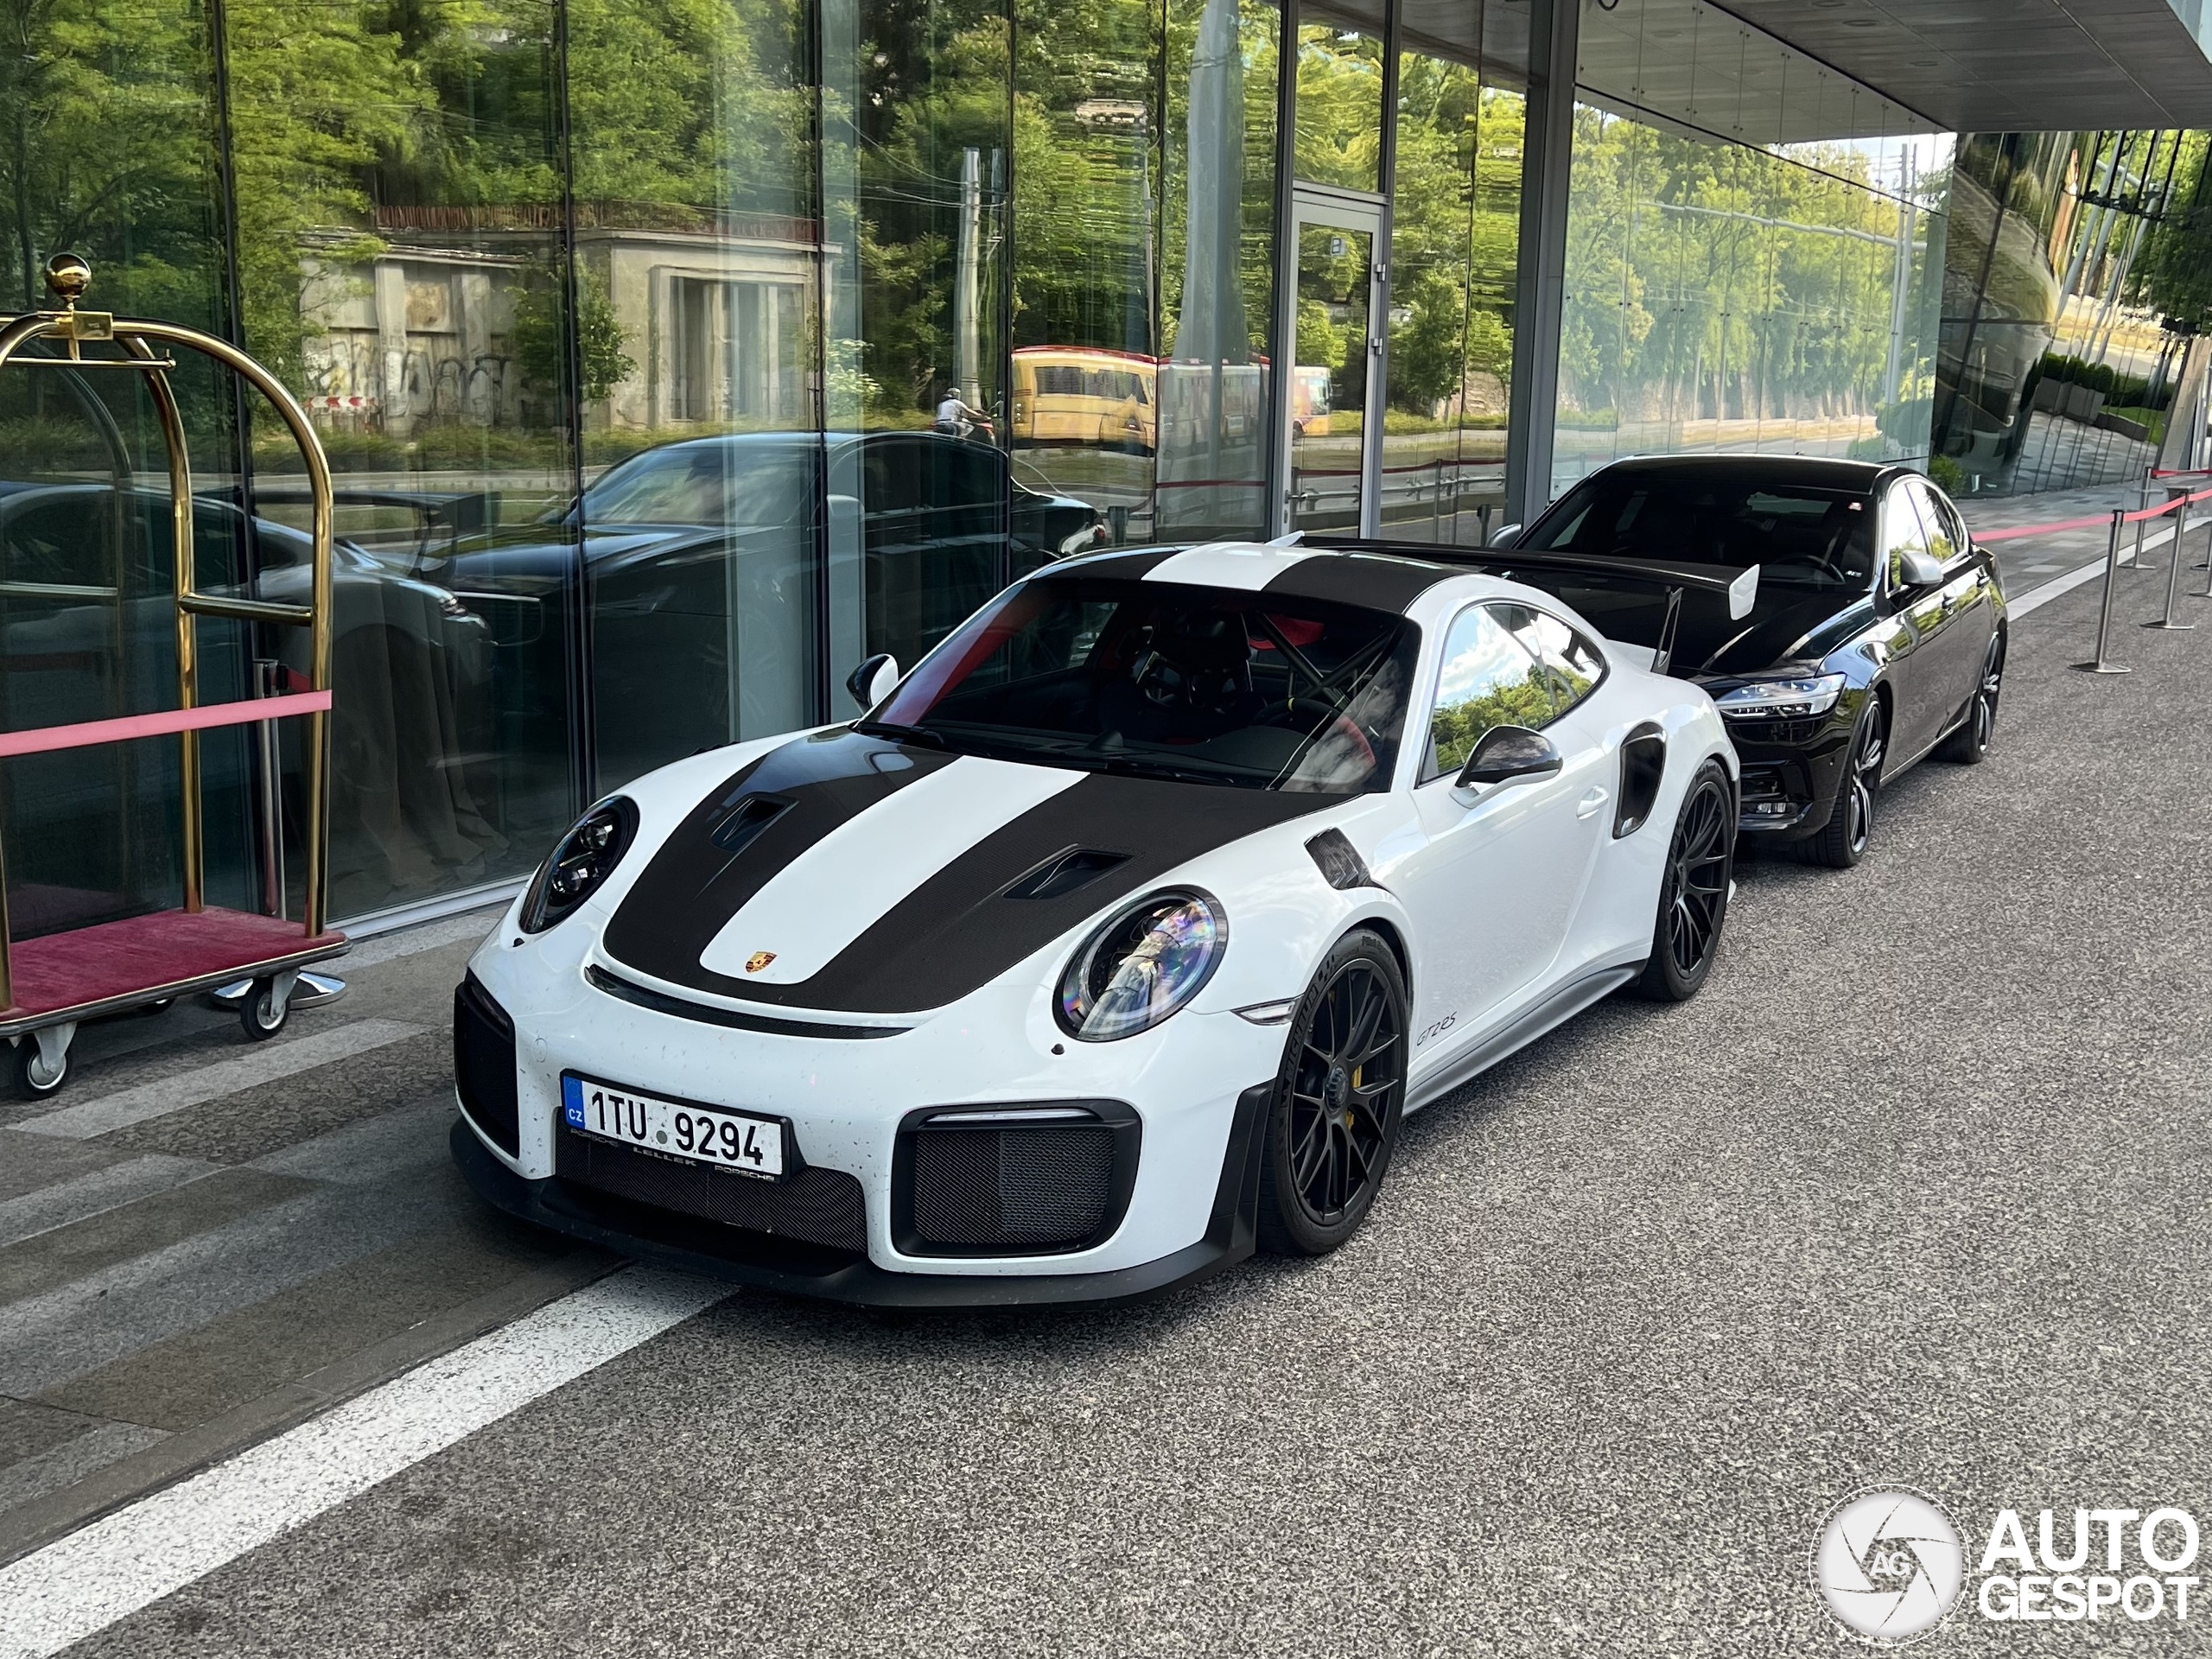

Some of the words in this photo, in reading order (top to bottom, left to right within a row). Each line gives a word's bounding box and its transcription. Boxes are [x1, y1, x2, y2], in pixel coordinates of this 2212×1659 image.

[569, 1109, 582, 1122] CZ
[592, 1090, 646, 1141] 1TU
[675, 1112, 763, 1166] 9294
[632, 1147, 697, 1166] LELLEK
[715, 1165, 776, 1182] PORSCHE
